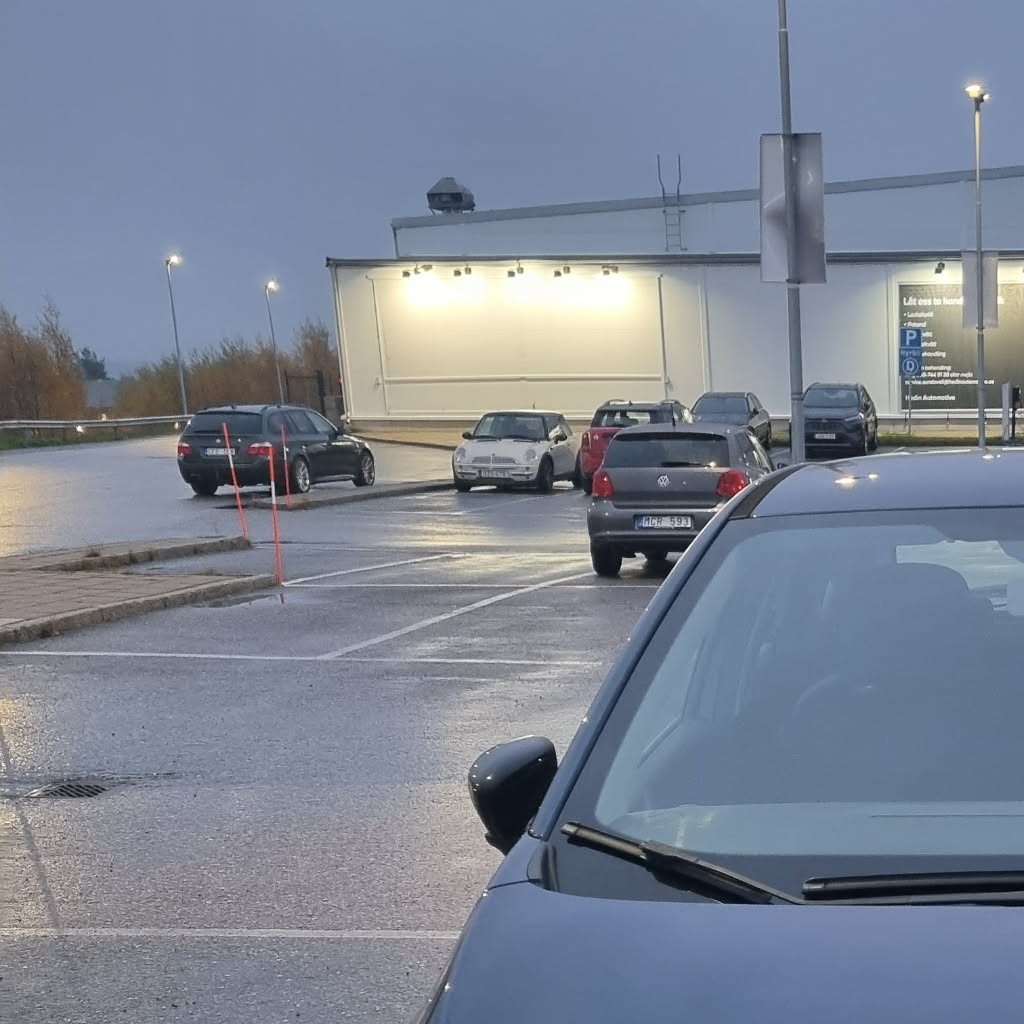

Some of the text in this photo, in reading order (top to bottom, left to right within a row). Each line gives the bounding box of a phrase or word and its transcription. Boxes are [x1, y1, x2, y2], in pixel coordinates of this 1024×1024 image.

[905, 330, 917, 346] P
[644, 516, 689, 526] MCR 593
